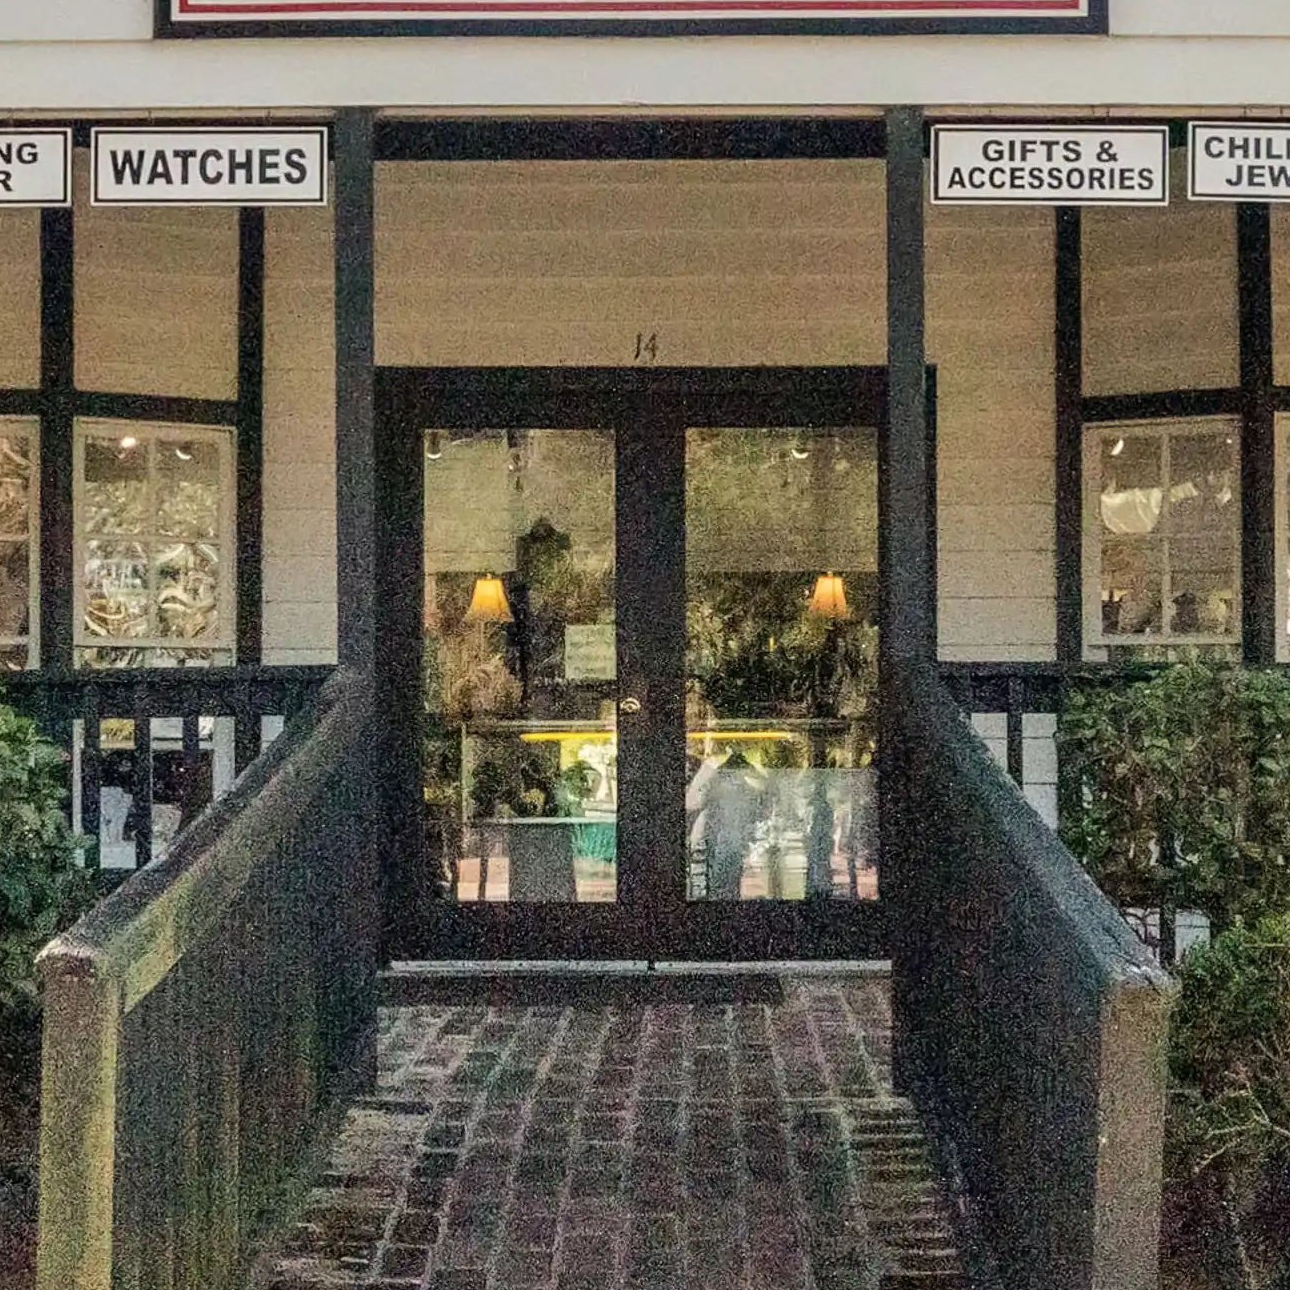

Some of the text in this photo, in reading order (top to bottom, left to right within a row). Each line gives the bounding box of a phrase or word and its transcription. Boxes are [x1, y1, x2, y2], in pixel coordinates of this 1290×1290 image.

[981, 139, 1119, 164] GIFTS &
[109, 148, 308, 186] WATCHES
[947, 165, 1155, 192] ACCESSORIES
[633, 331, 659, 361] 14
